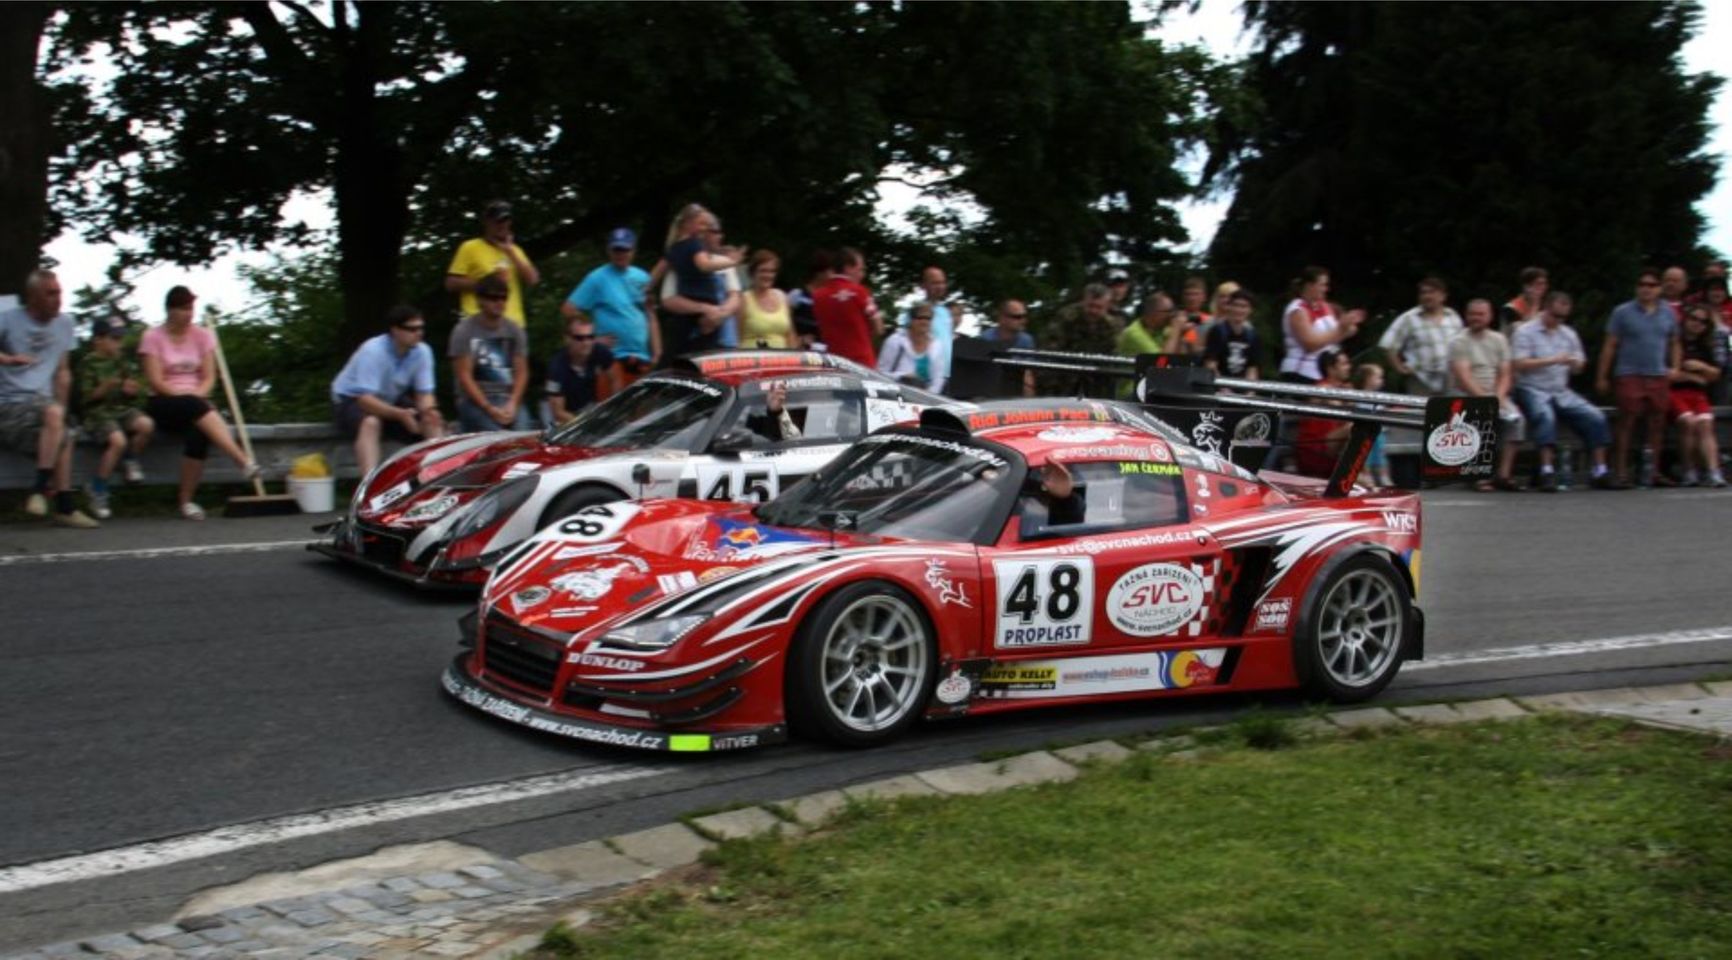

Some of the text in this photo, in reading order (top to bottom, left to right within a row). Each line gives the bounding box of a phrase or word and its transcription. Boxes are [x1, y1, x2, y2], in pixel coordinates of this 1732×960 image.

[704, 470, 769, 502] 45
[1002, 562, 1082, 624] 48
[1123, 582, 1189, 609] SVC
[1004, 624, 1082, 645] PROPLAST
[566, 652, 646, 672] DUNLOP
[1020, 667, 1055, 679] KELLY
